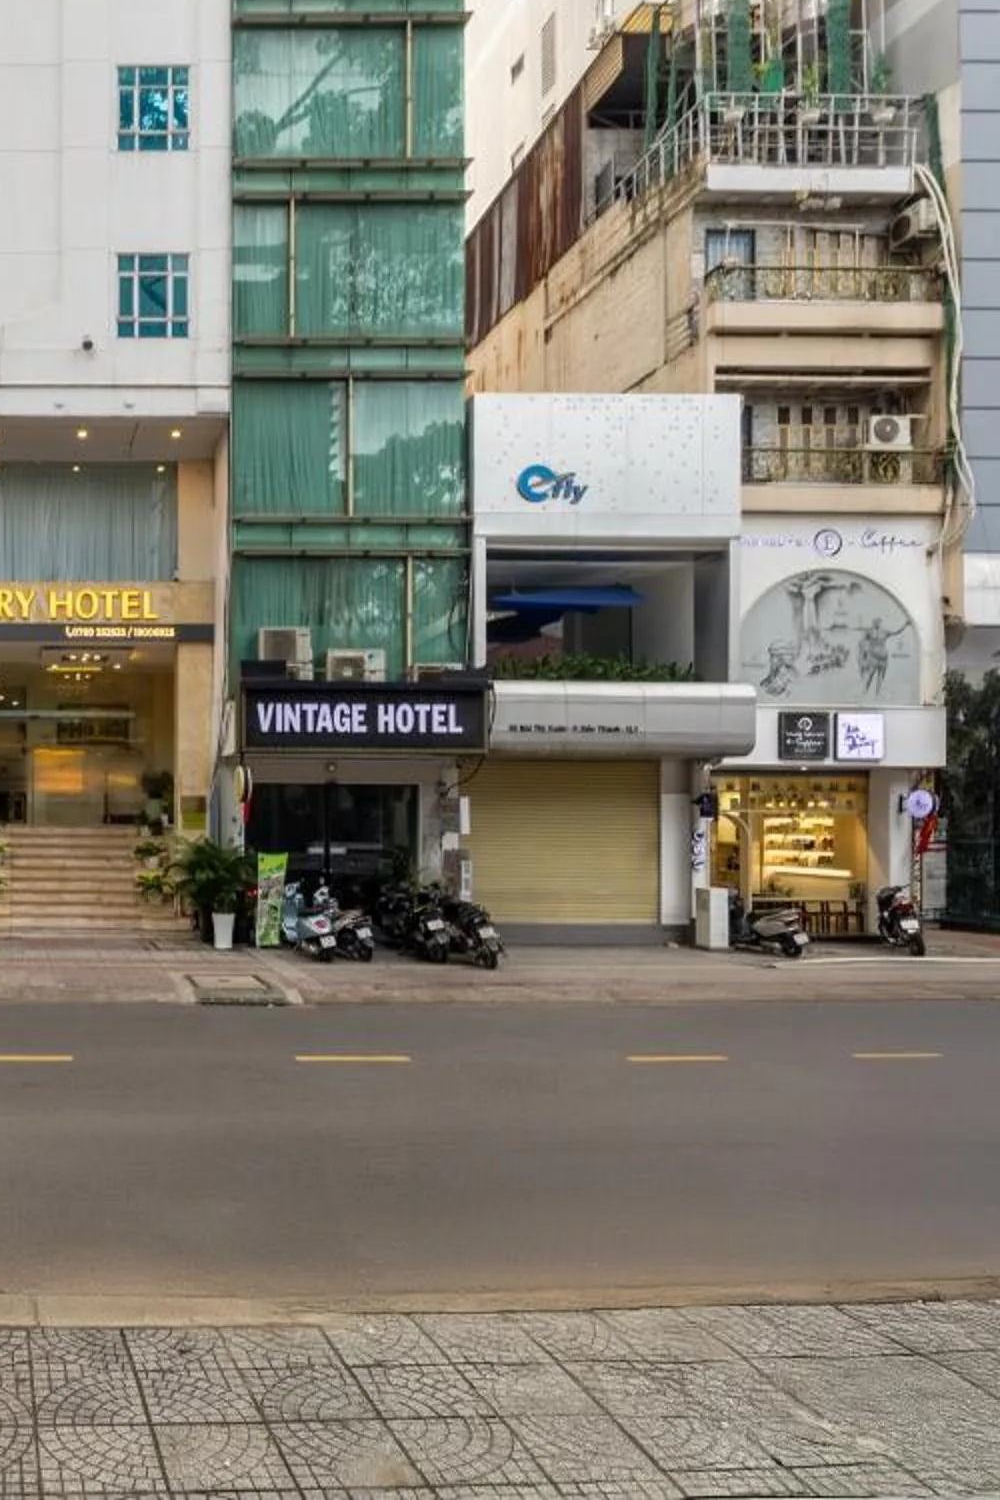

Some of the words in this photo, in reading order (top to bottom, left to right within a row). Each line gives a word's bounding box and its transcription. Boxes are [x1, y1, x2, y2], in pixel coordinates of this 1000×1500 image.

[50, 589, 159, 619] HOTEL
[257, 703, 368, 733] VINTAGE
[378, 703, 463, 734] HOTEL
